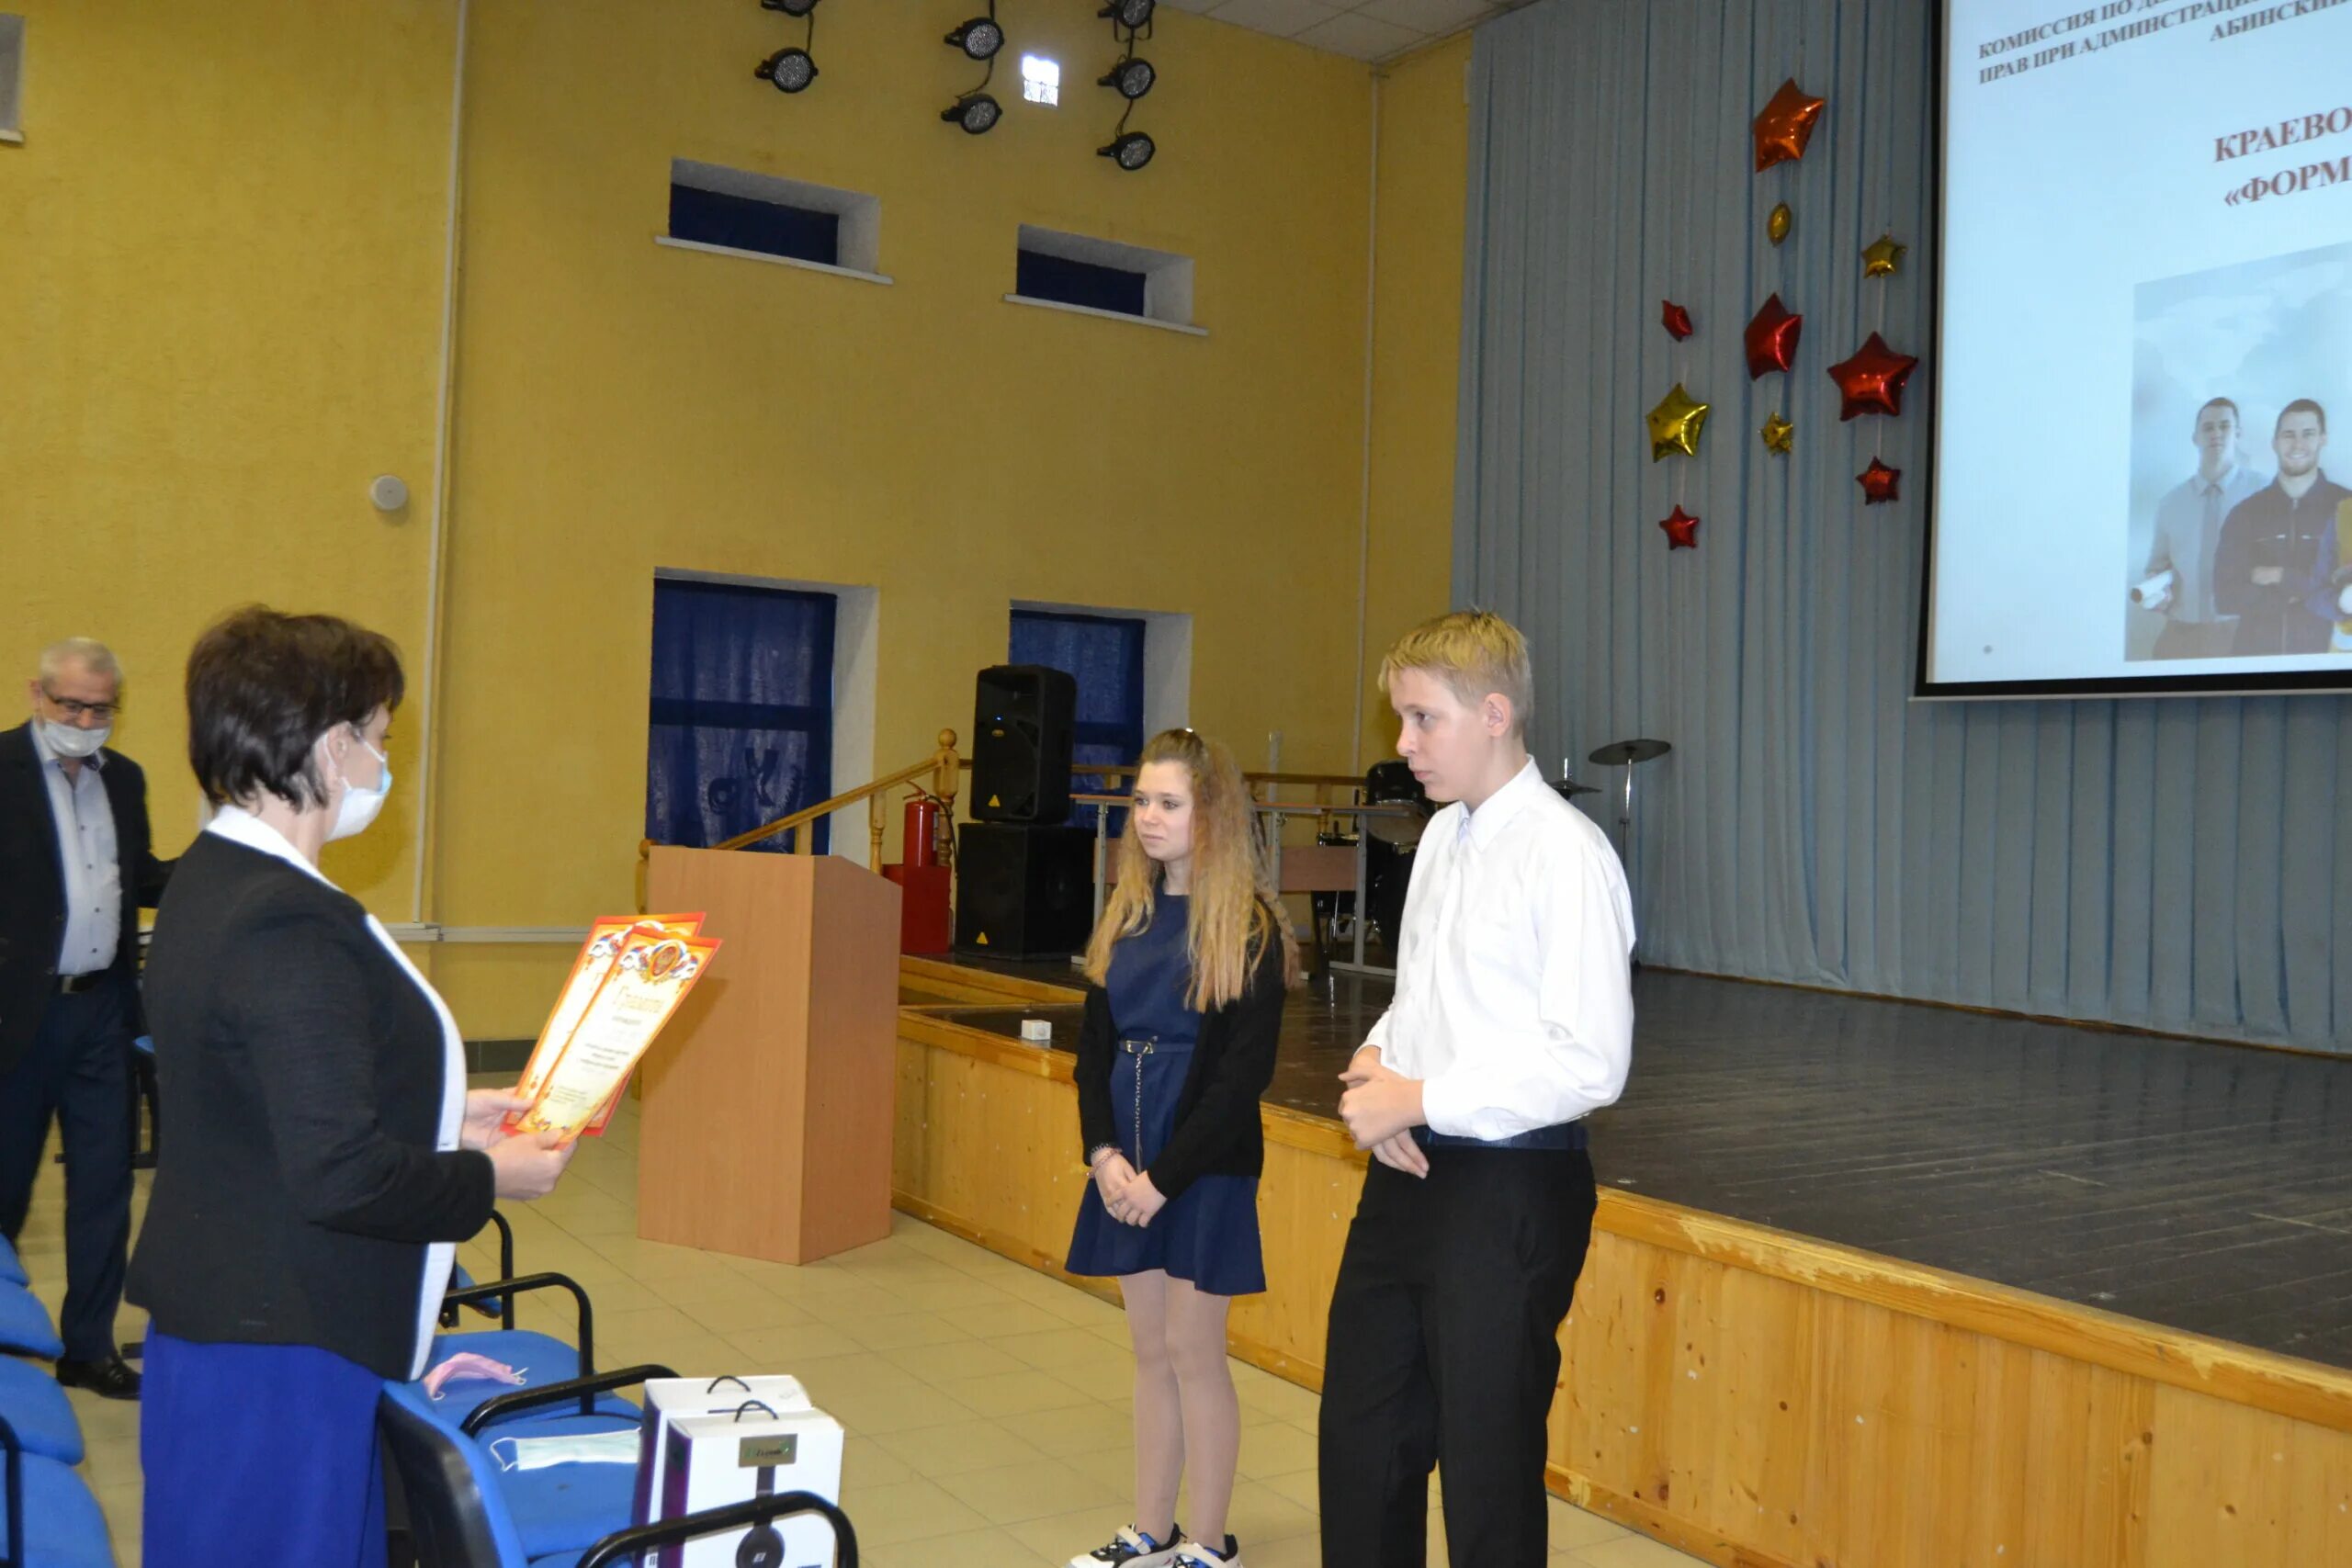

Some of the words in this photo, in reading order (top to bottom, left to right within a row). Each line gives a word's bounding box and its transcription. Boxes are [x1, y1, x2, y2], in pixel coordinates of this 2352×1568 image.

[1978, 8, 2097, 59] КОМИССИЯ
[2101, 0, 2132, 20] ПО
[1979, 57, 2029, 85] ПРАВ
[2034, 41, 2075, 67] ПРИ
[2080, 0, 2259, 54] АДМИНСТРАЦ
[2213, 107, 2352, 163] КРАЕВО
